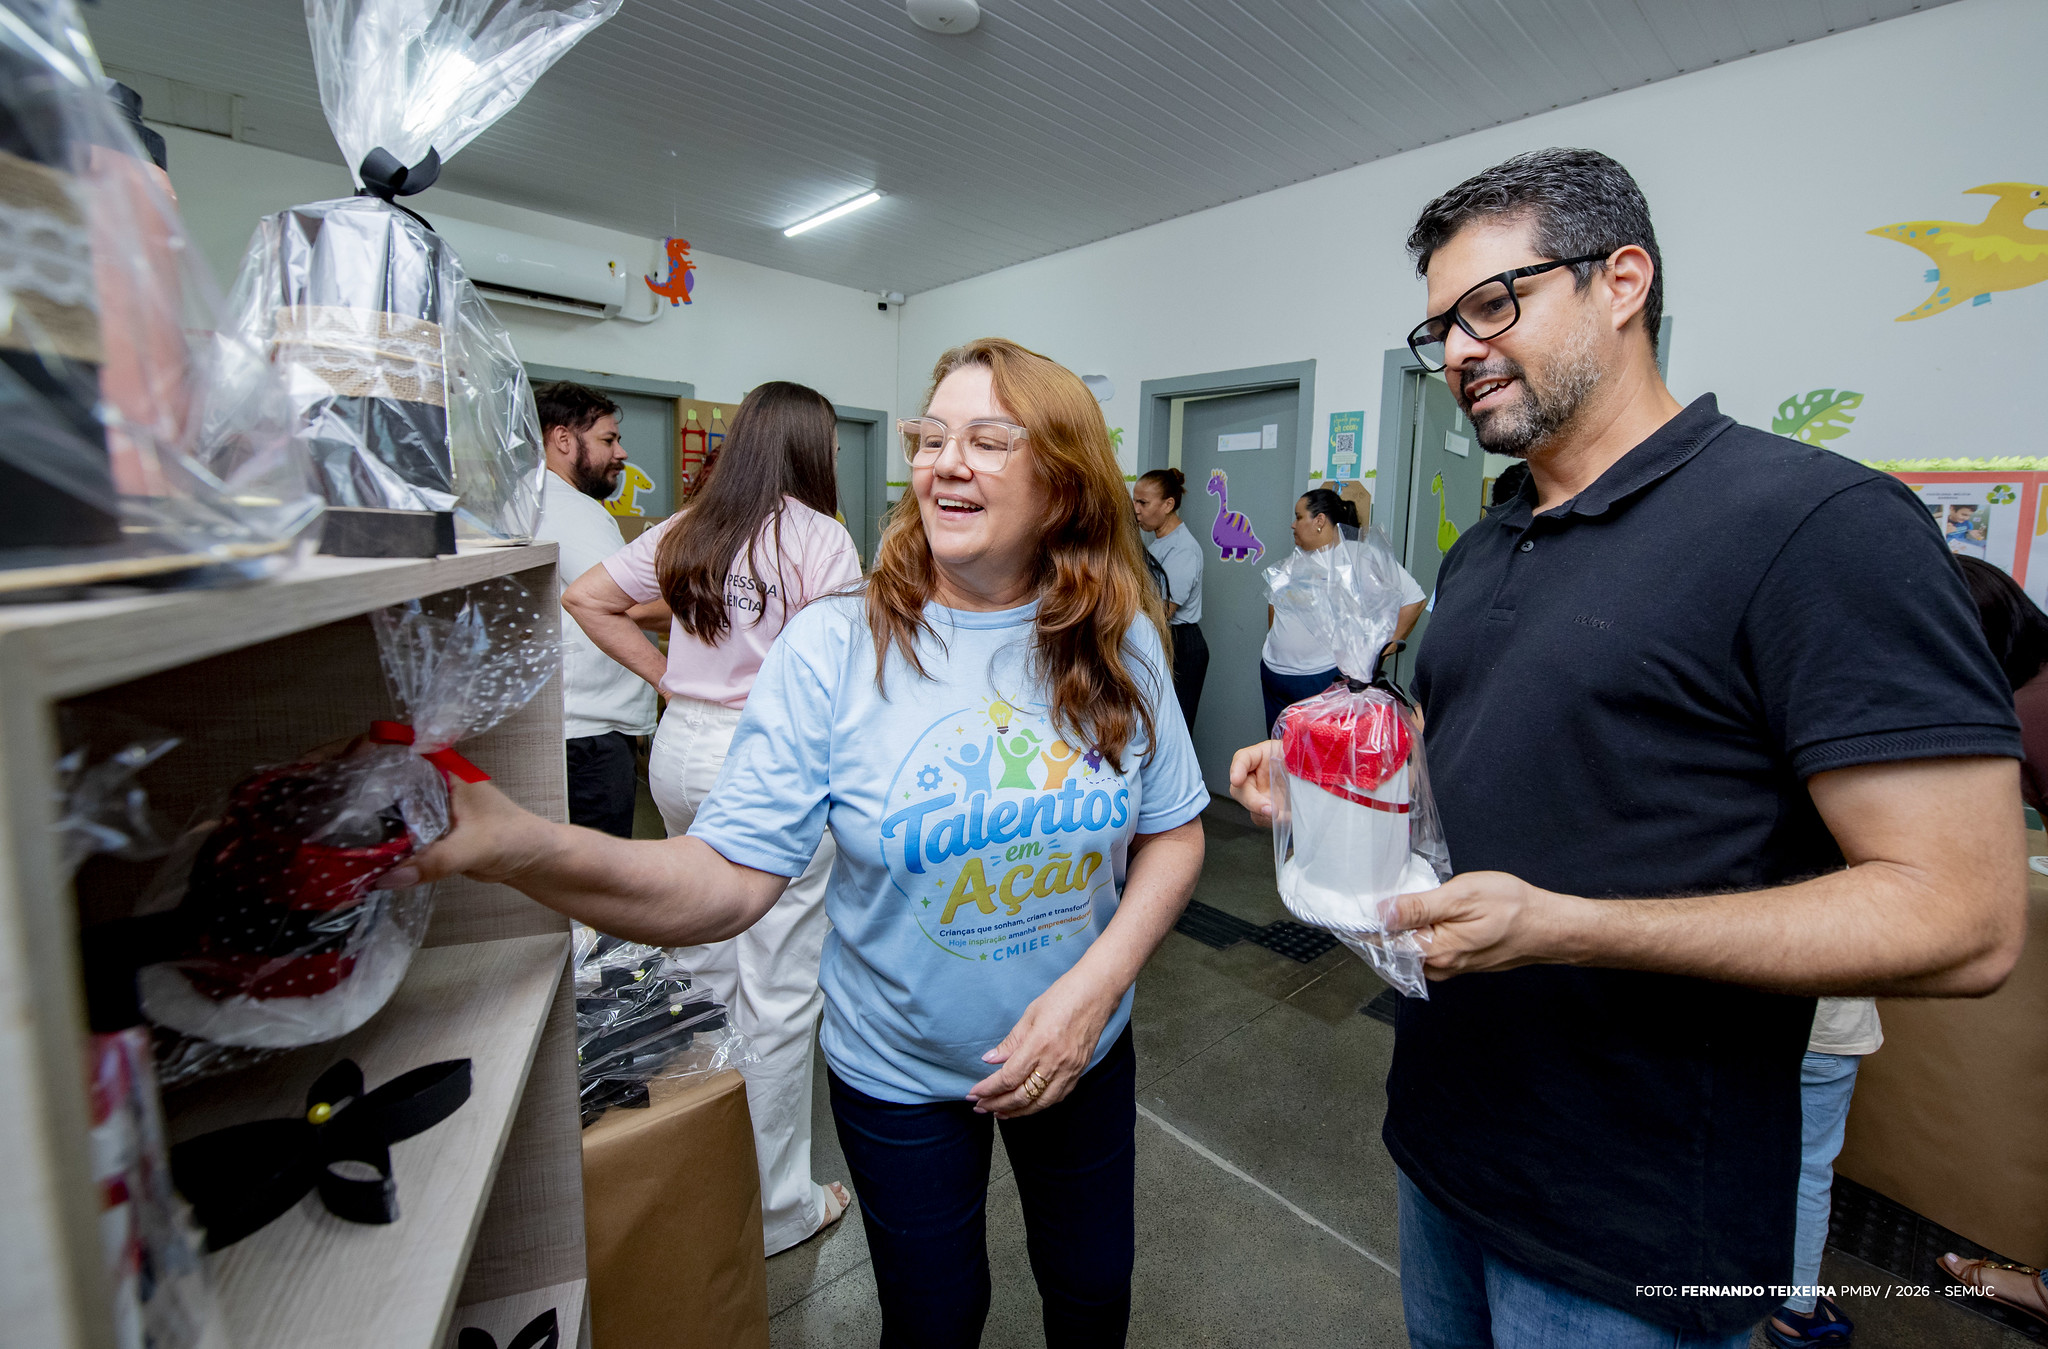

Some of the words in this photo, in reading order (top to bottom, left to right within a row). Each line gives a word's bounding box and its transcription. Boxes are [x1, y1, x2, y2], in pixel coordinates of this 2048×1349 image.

[880, 778, 1129, 875] Talentos
[1005, 840, 1044, 863] em
[940, 851, 1103, 925] Ação
[939, 928, 976, 938] Crianças
[977, 925, 993, 935] que
[993, 918, 1026, 931] sonham,
[1026, 912, 1047, 923] criam
[948, 936, 967, 948] Hoje
[968, 934, 1007, 947] inspiração
[1008, 926, 1037, 940] amanhã
[992, 934, 1050, 962] CMIEE
